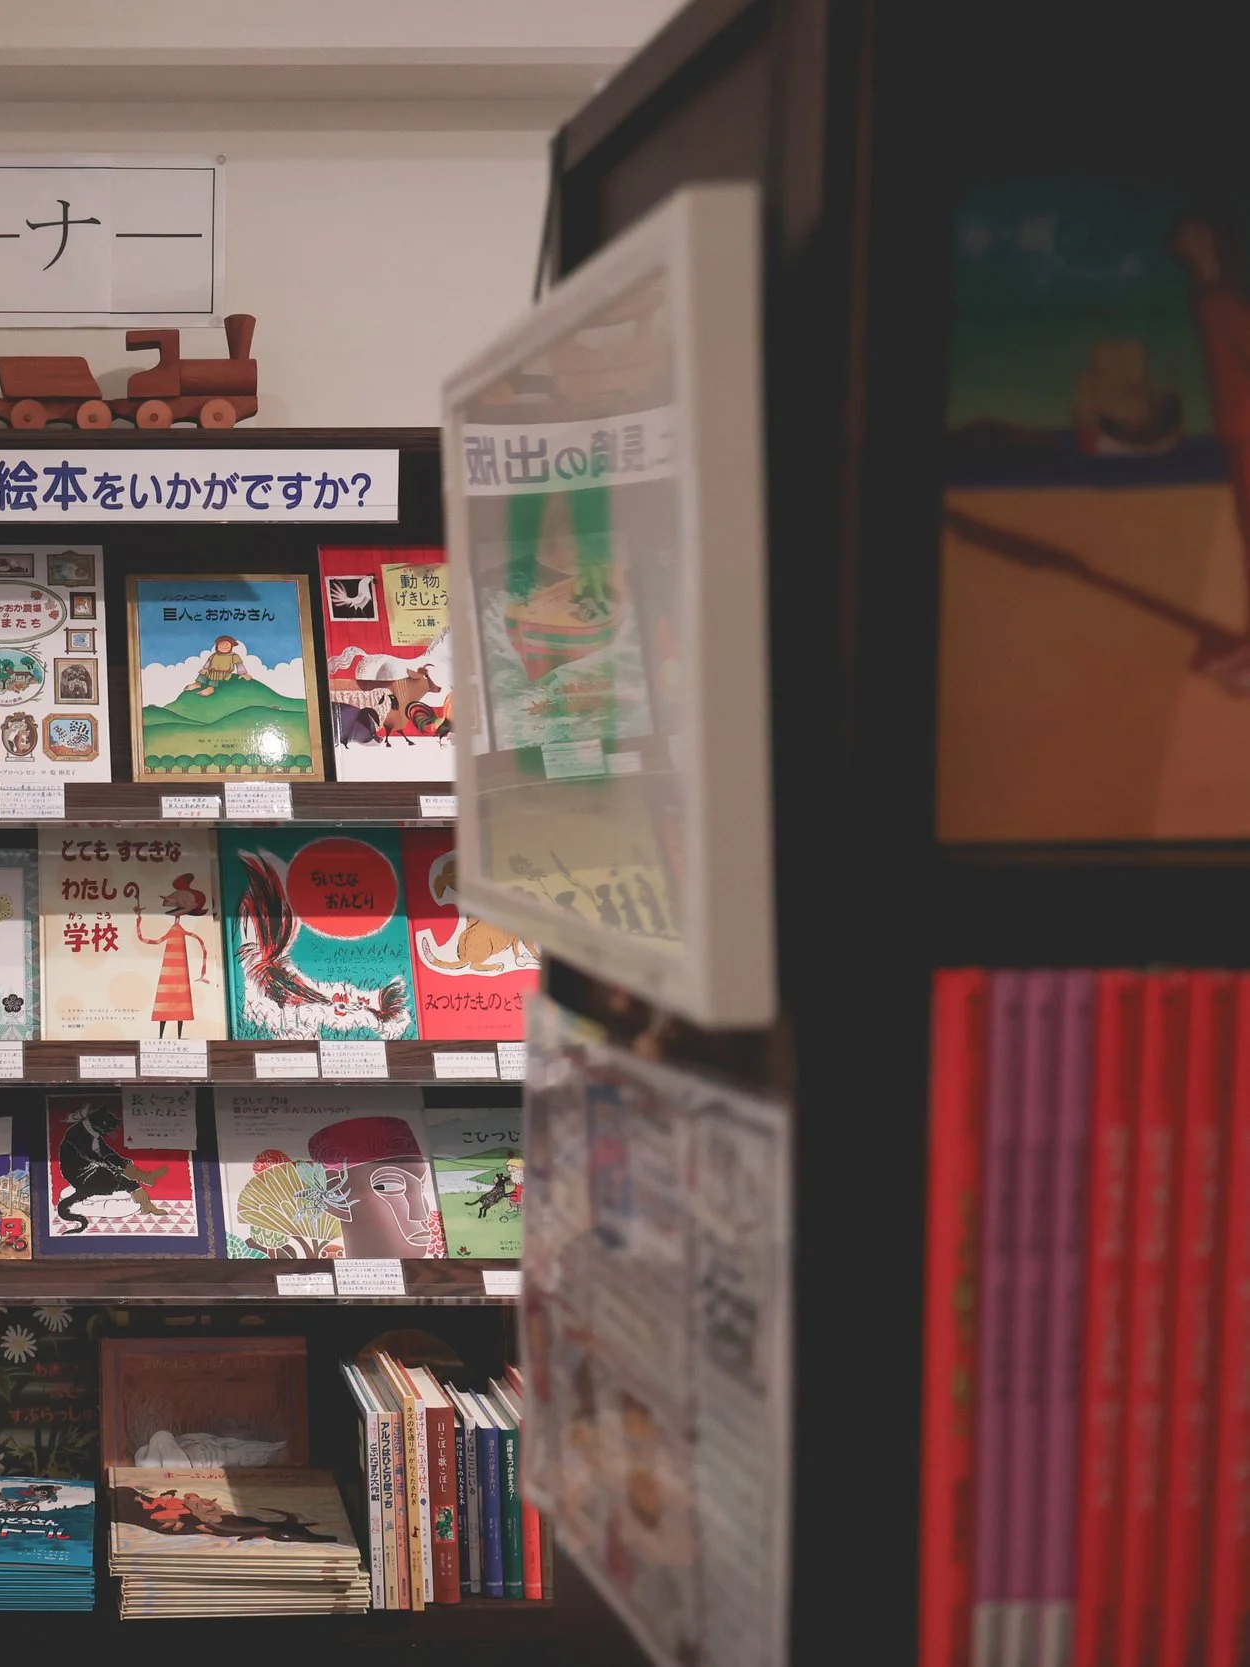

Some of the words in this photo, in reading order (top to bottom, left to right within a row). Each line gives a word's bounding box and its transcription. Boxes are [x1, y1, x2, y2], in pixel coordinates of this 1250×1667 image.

[163, 607, 275, 623] 巨人とおかみさん
[62, 840, 109, 863] とても
[117, 840, 181, 863] すてきな
[62, 877, 139, 900] わたしの
[310, 871, 358, 887] ちいさな
[325, 893, 374, 910] おんどり
[63, 923, 120, 953] 学校
[380, 1421, 394, 1509] アルフはひとりぼっち
